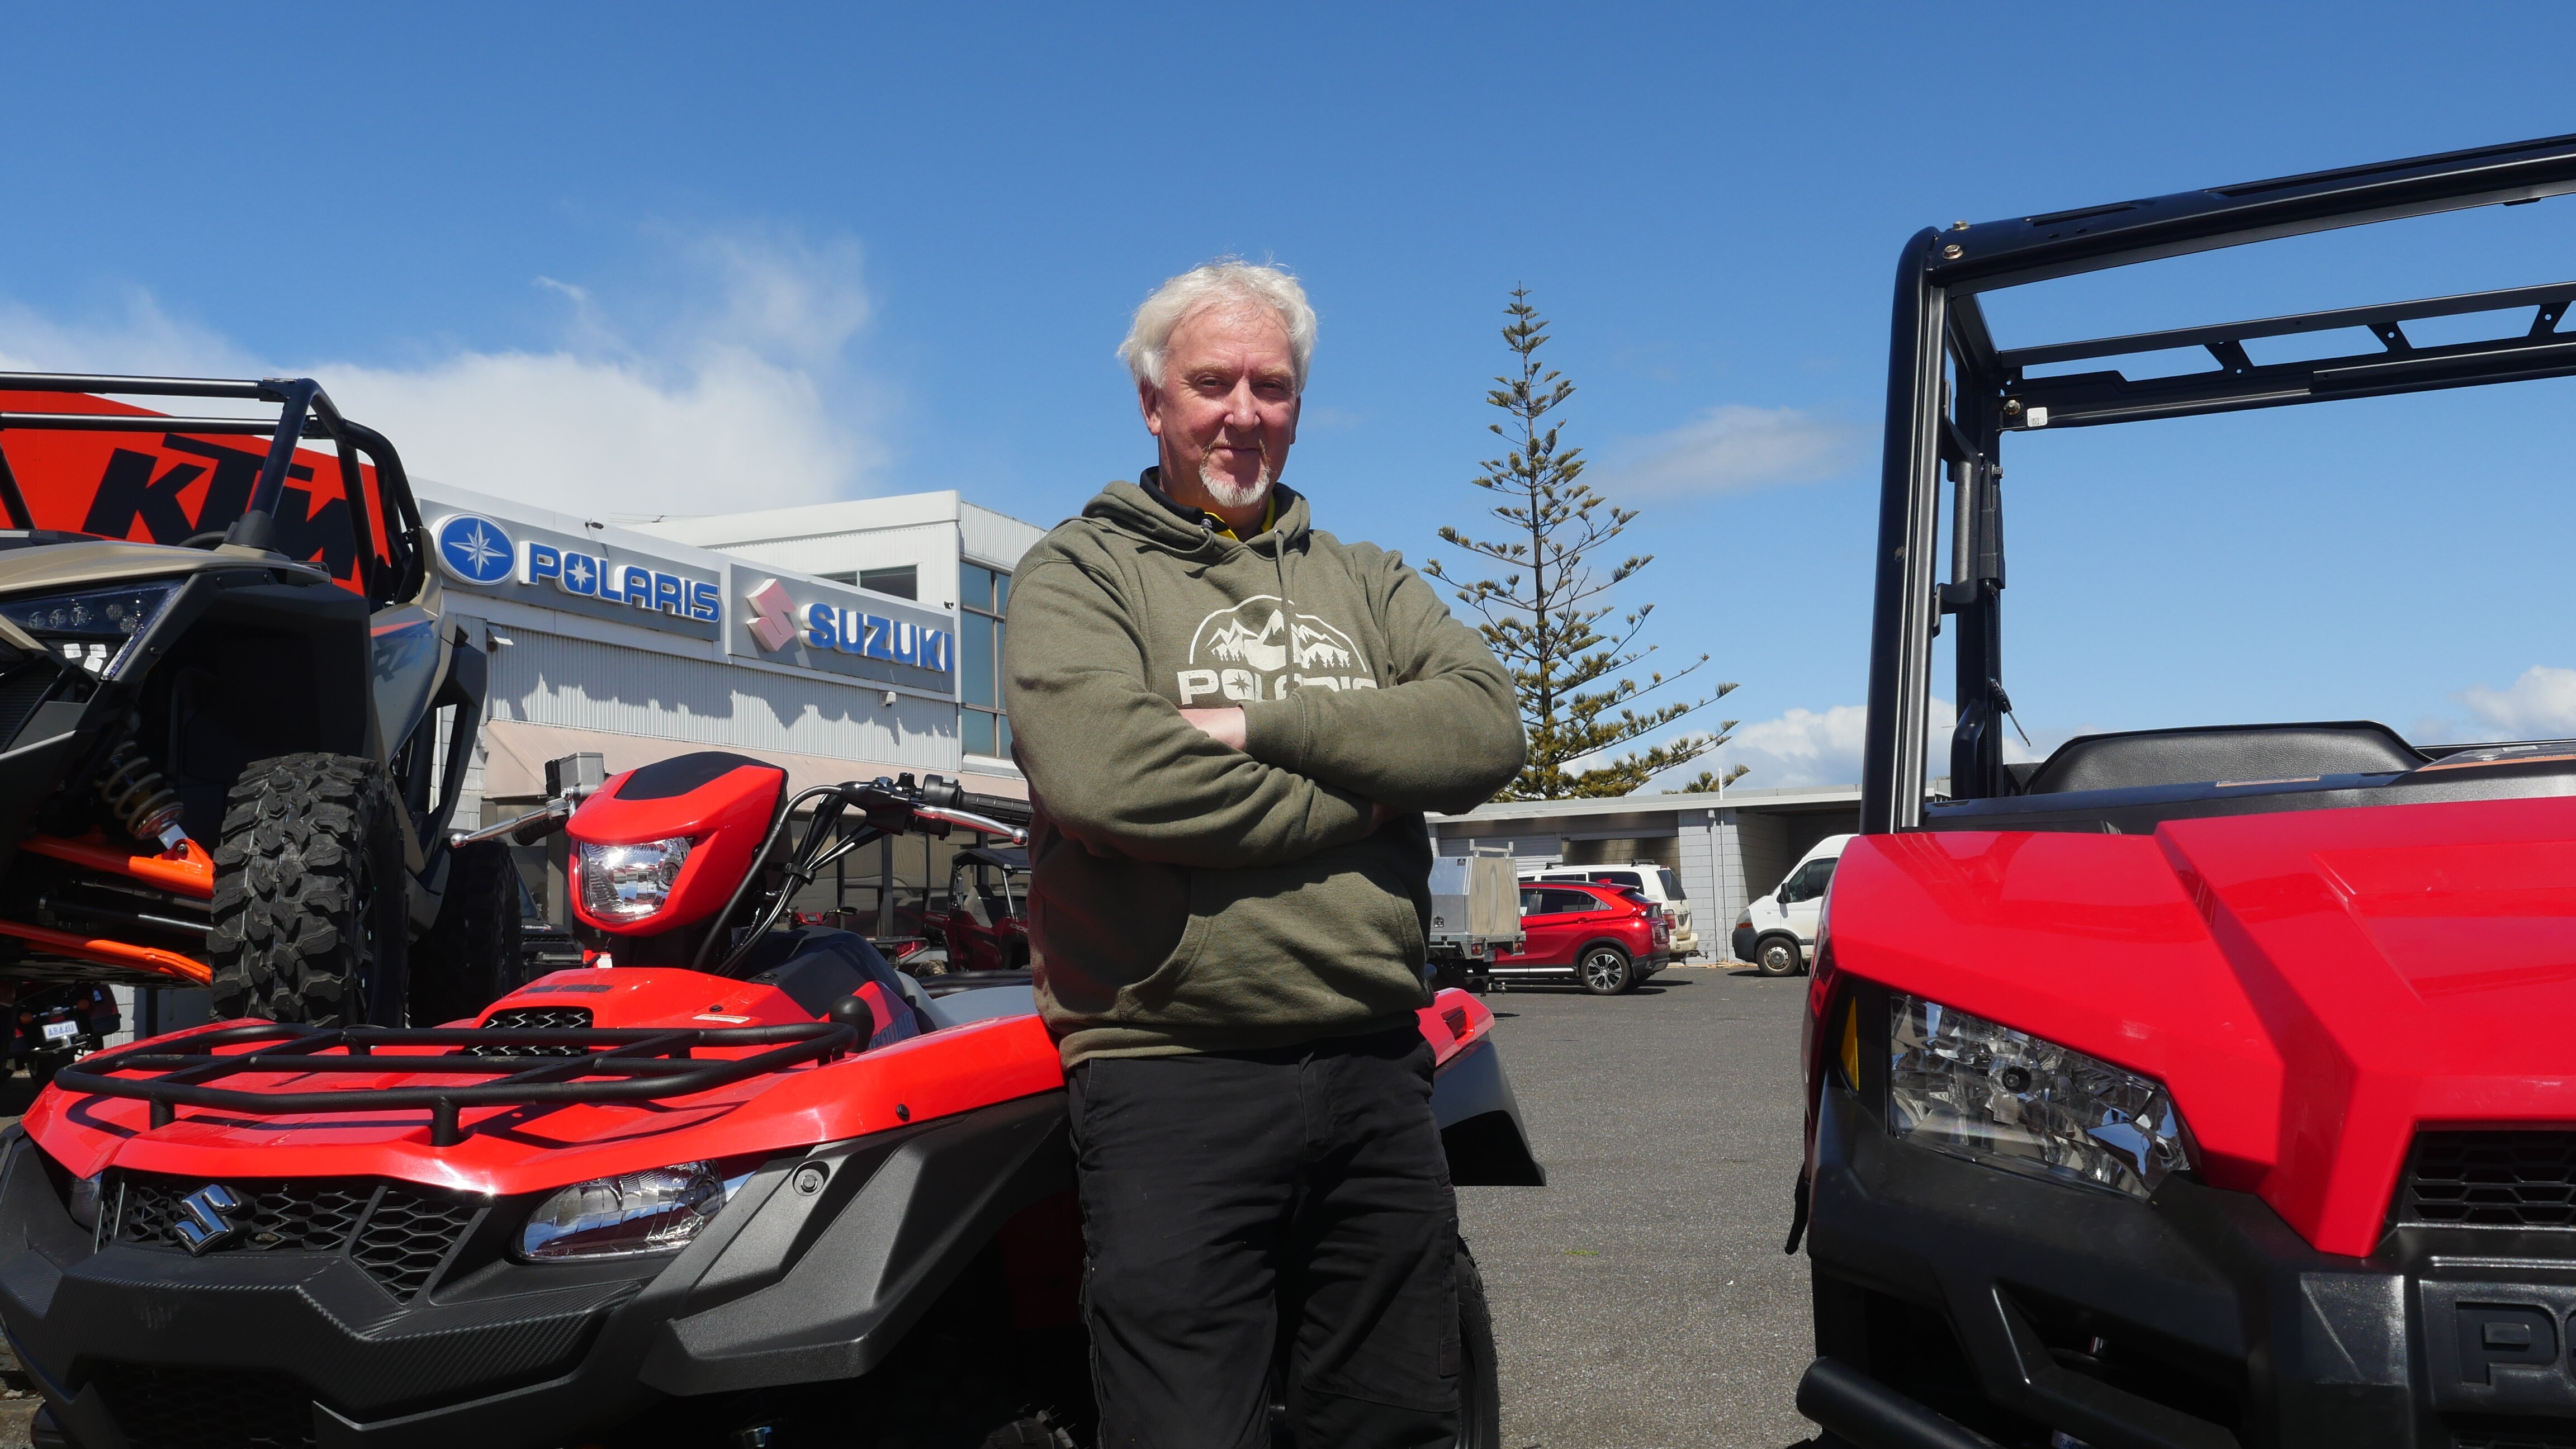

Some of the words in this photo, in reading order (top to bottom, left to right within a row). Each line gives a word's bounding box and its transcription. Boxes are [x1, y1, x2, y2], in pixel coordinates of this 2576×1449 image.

[82, 432, 354, 581] KTM
[524, 542, 720, 623] POLARIS
[804, 603, 954, 673] SUZUKI
[2455, 1301, 2576, 1386] P
